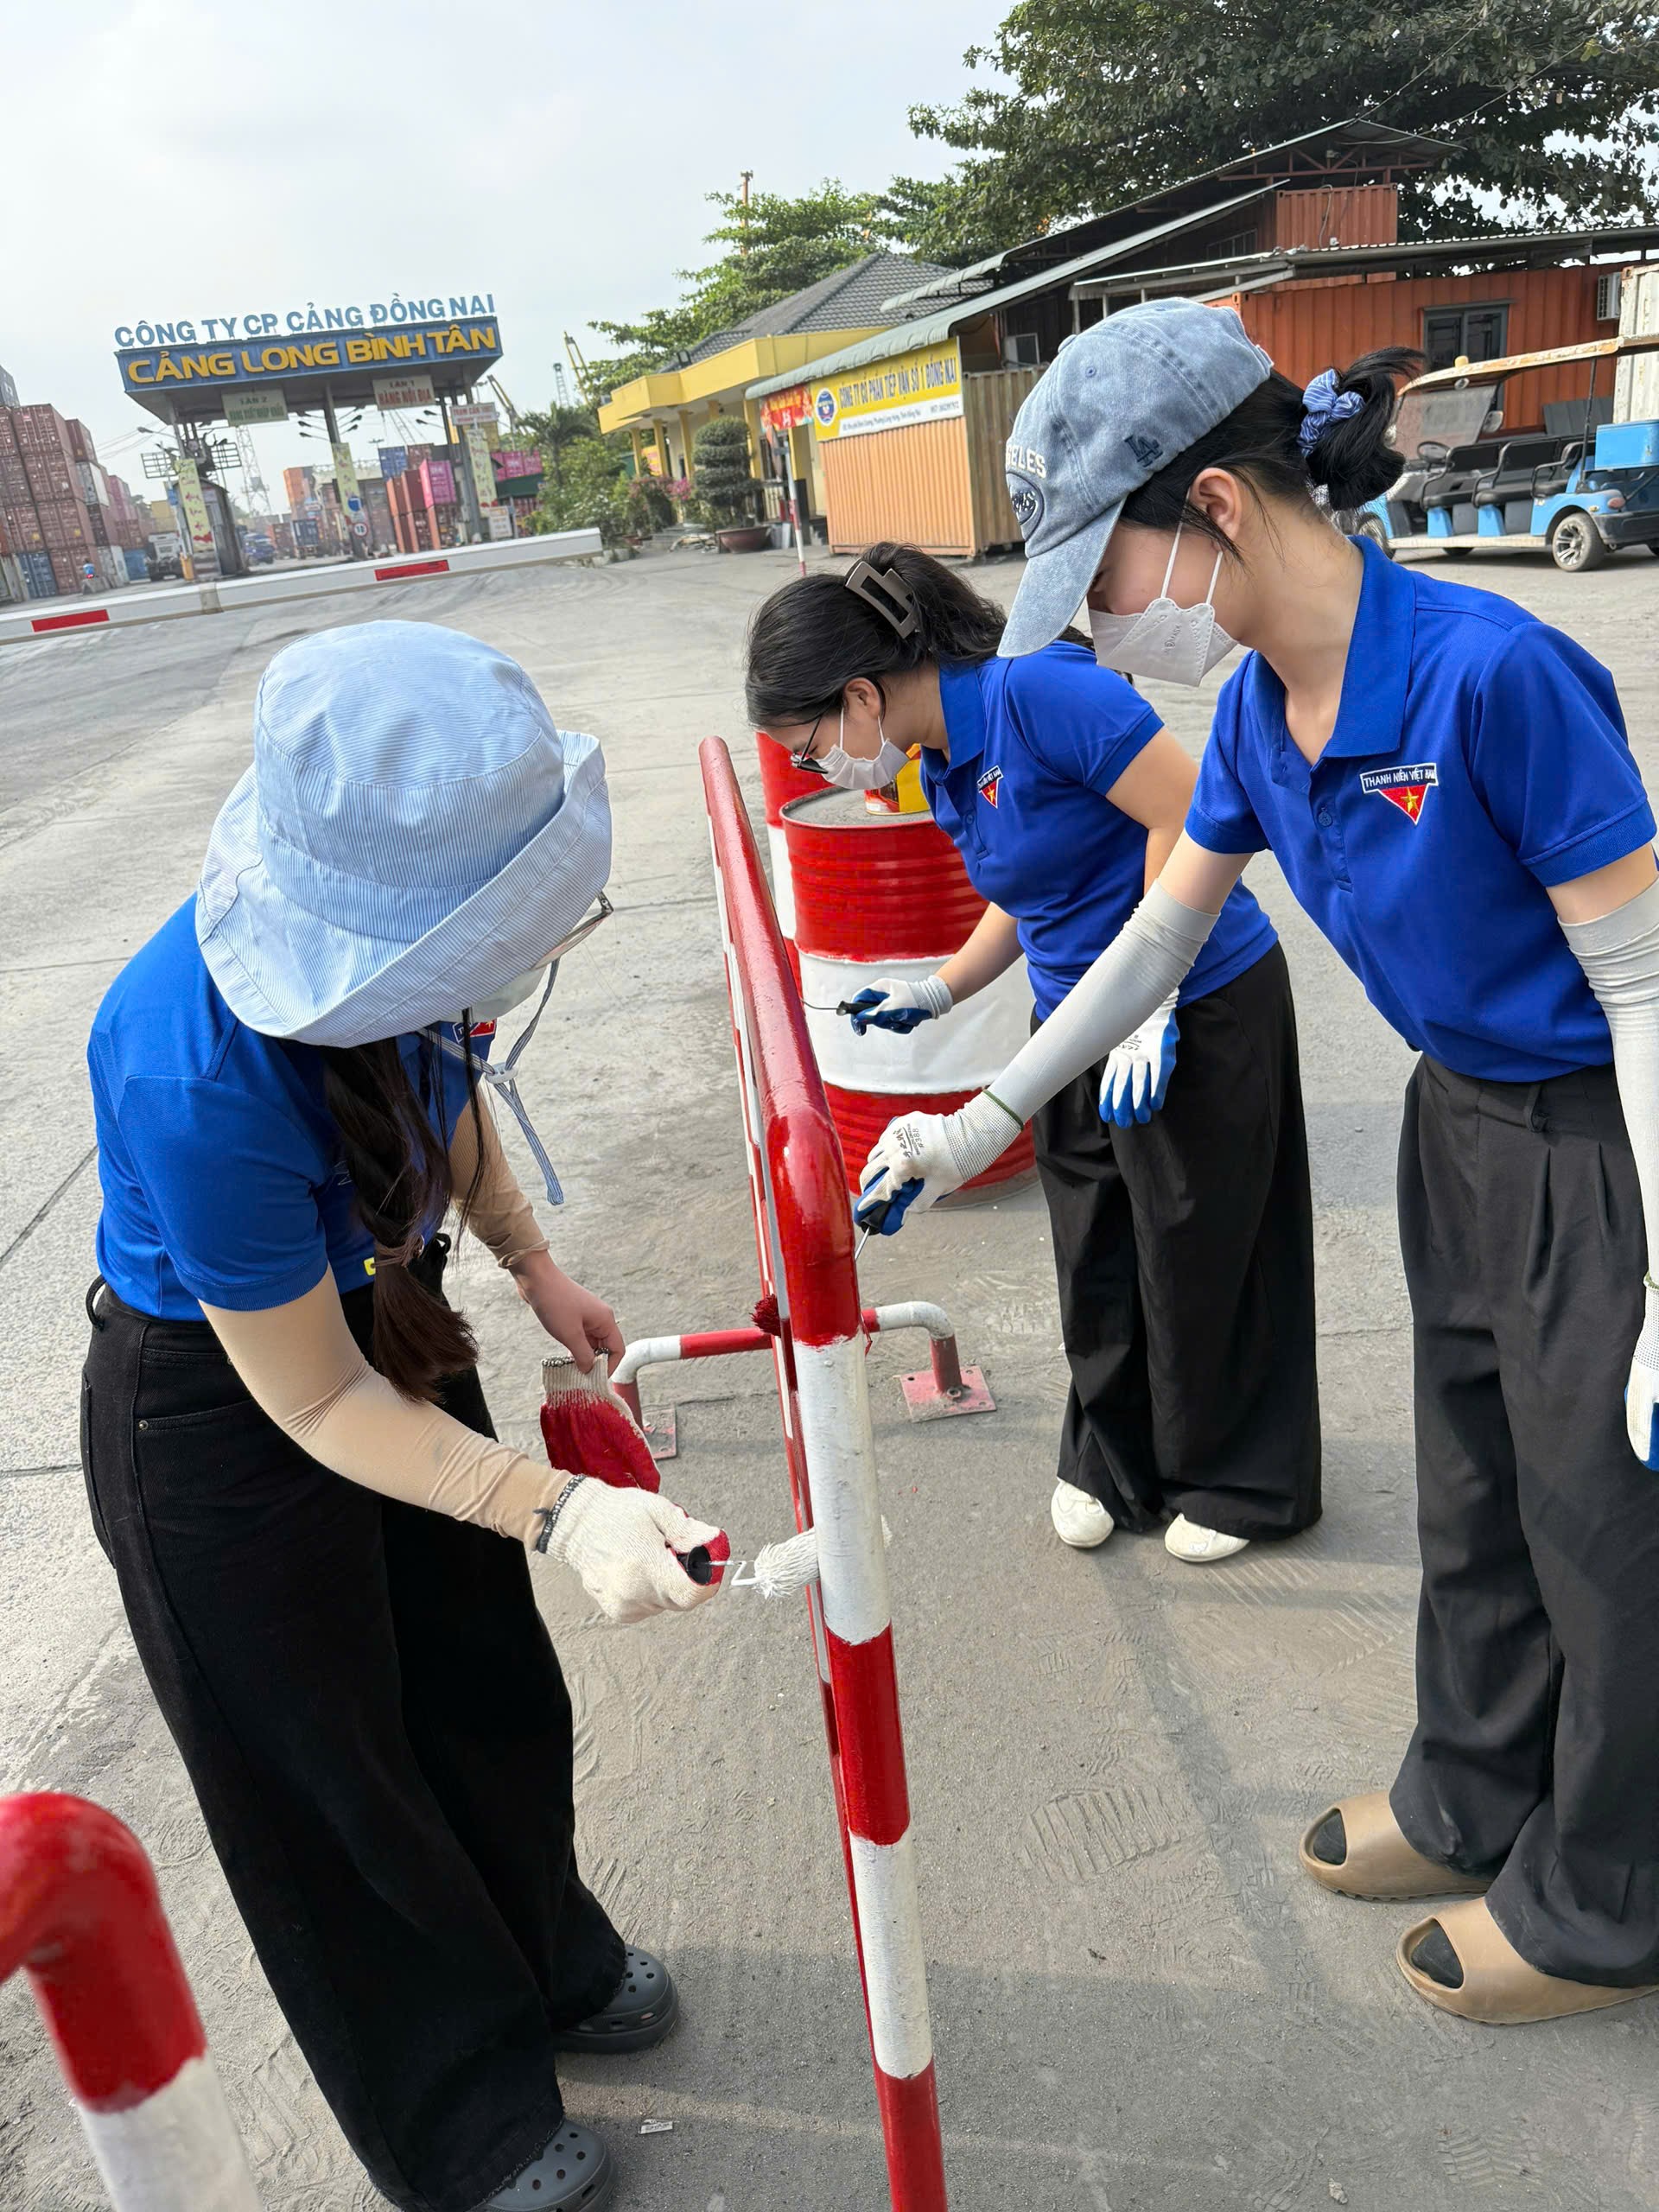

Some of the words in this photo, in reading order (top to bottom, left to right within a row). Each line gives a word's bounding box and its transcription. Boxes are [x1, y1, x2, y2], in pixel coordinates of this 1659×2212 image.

[114, 320, 197, 347] CÔNG
[201, 316, 237, 340] TY
[243, 313, 278, 335] CP
[286, 302, 364, 332] CẢNG
[370, 292, 445, 324] ĐỒNG
[448, 294, 495, 317] NAI
[128, 351, 236, 384] CẢNG
[241, 342, 340, 373] LONG
[346, 332, 426, 364] BÌNH
[426, 324, 497, 354] TÂN
[1124, 435, 1163, 467] LA
[1363, 774, 1392, 788] THANH
[1393, 769, 1408, 783] NIÊN
[1408, 767, 1424, 782] VIỆT
